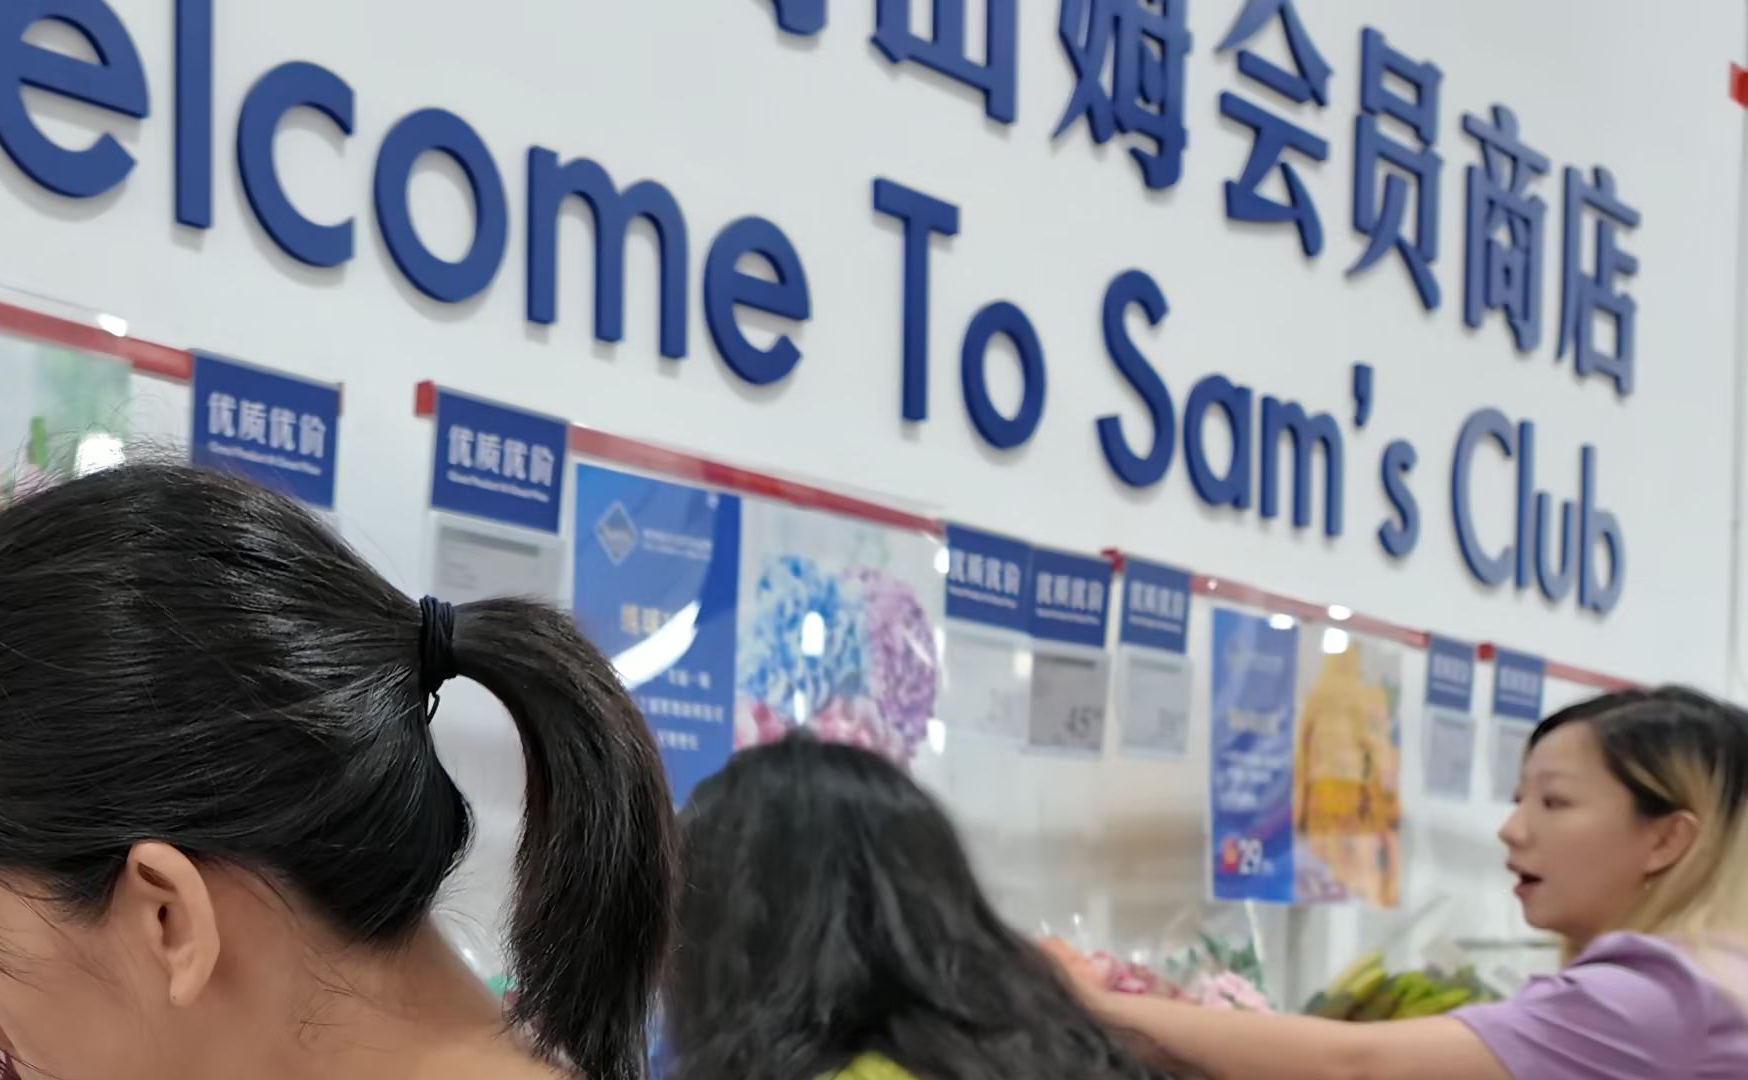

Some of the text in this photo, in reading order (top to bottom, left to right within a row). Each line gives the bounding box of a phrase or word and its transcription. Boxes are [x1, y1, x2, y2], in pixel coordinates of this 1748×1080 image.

[208, 391, 326, 458] 优质优价
[872, 176, 1048, 450] To
[1096, 268, 1421, 559] Sam's
[1451, 406, 1626, 615] Club
[448, 424, 555, 487] 优质优价
